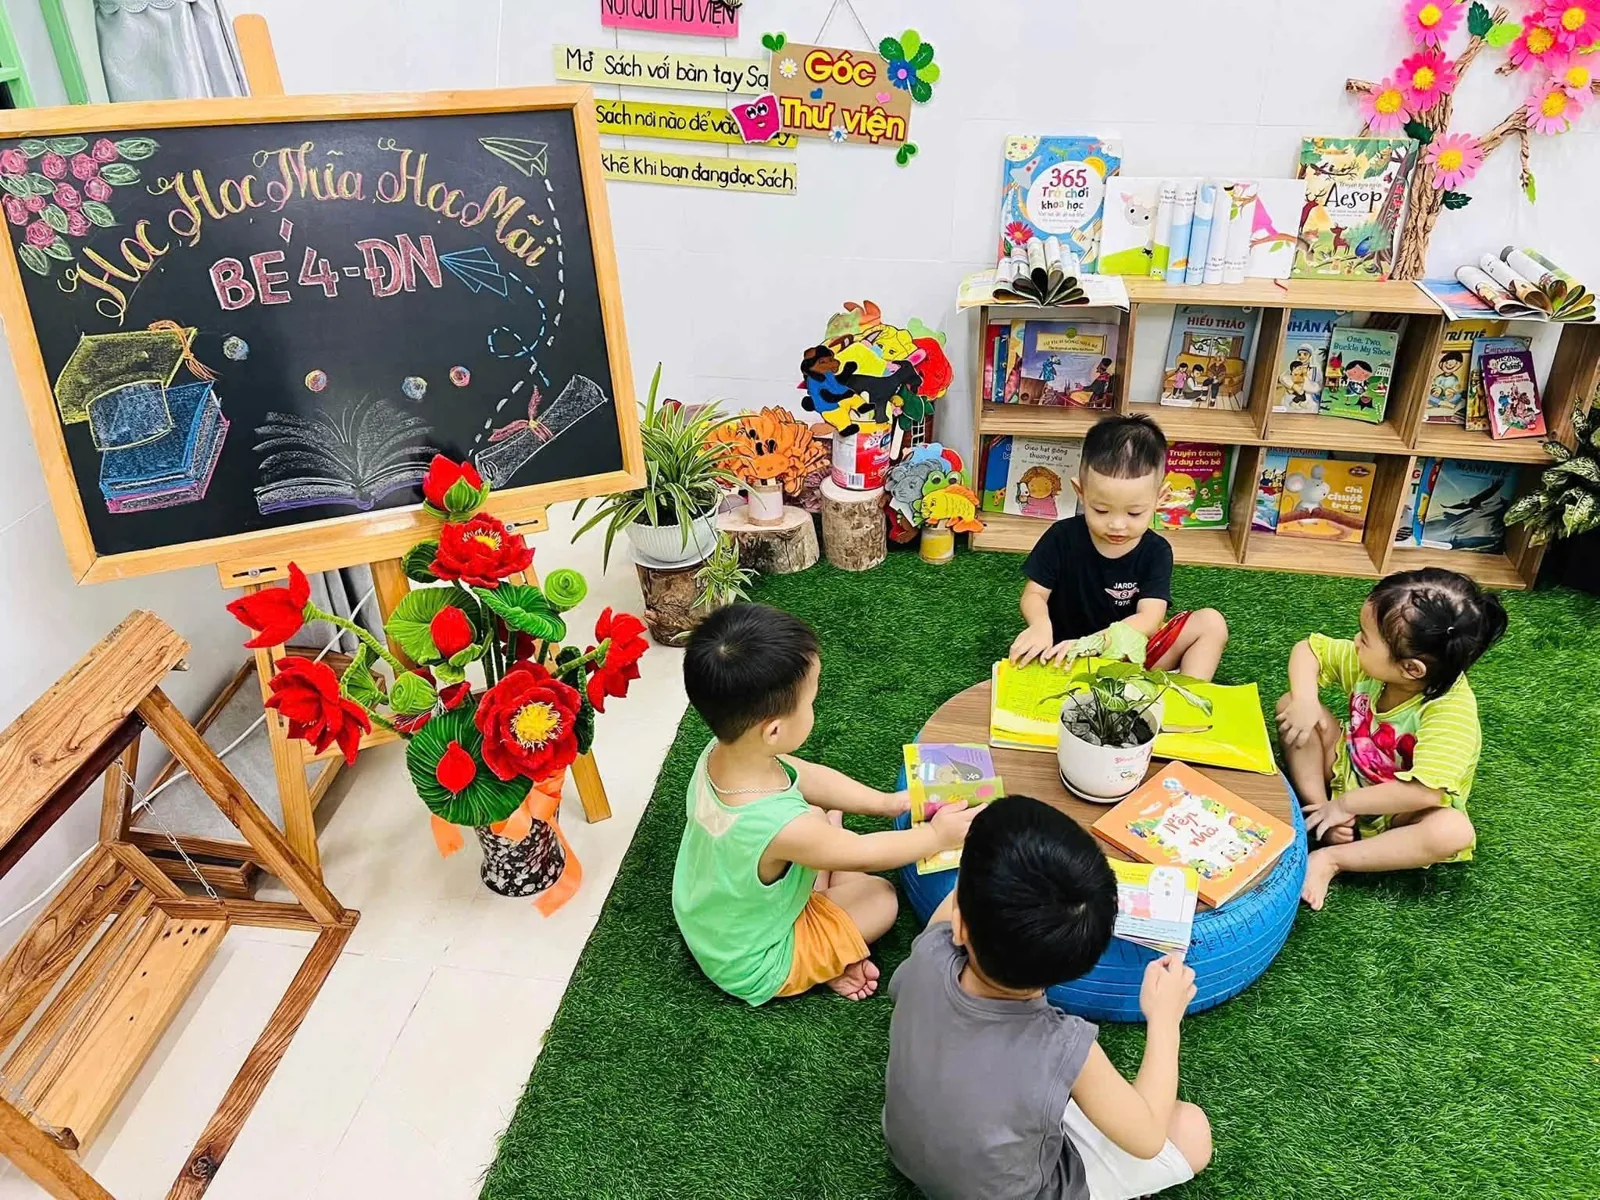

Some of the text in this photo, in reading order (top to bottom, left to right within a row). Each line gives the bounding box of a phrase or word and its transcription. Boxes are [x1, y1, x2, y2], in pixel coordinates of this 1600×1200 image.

[566, 48, 594, 73] Mở
[604, 54, 642, 77] Sách
[676, 60, 707, 82] bàn
[713, 64, 743, 92] tay
[747, 65, 769, 90] Sạ
[804, 49, 876, 87] Góc
[595, 102, 631, 125] Sách
[659, 110, 686, 129] nào
[689, 110, 711, 131] để
[712, 115, 740, 135] vào
[779, 96, 906, 144] Thư viện
[660, 160, 689, 182] bạn
[1049, 168, 1087, 188] 365
[1065, 187, 1089, 198] chơi
[1323, 182, 1382, 213] Aesop
[1041, 200, 1084, 211] khoa học
[209, 217, 294, 311] BÉ
[1187, 314, 1213, 327] HIẾU
[1333, 342, 1391, 357] Buckle My Shoe
[1169, 449, 1221, 459] Truyện tranh
[1178, 458, 1194, 467] duy
[1194, 458, 1209, 466] cho
[1327, 492, 1363, 504] chuột
[1189, 824, 1219, 847] nhà
